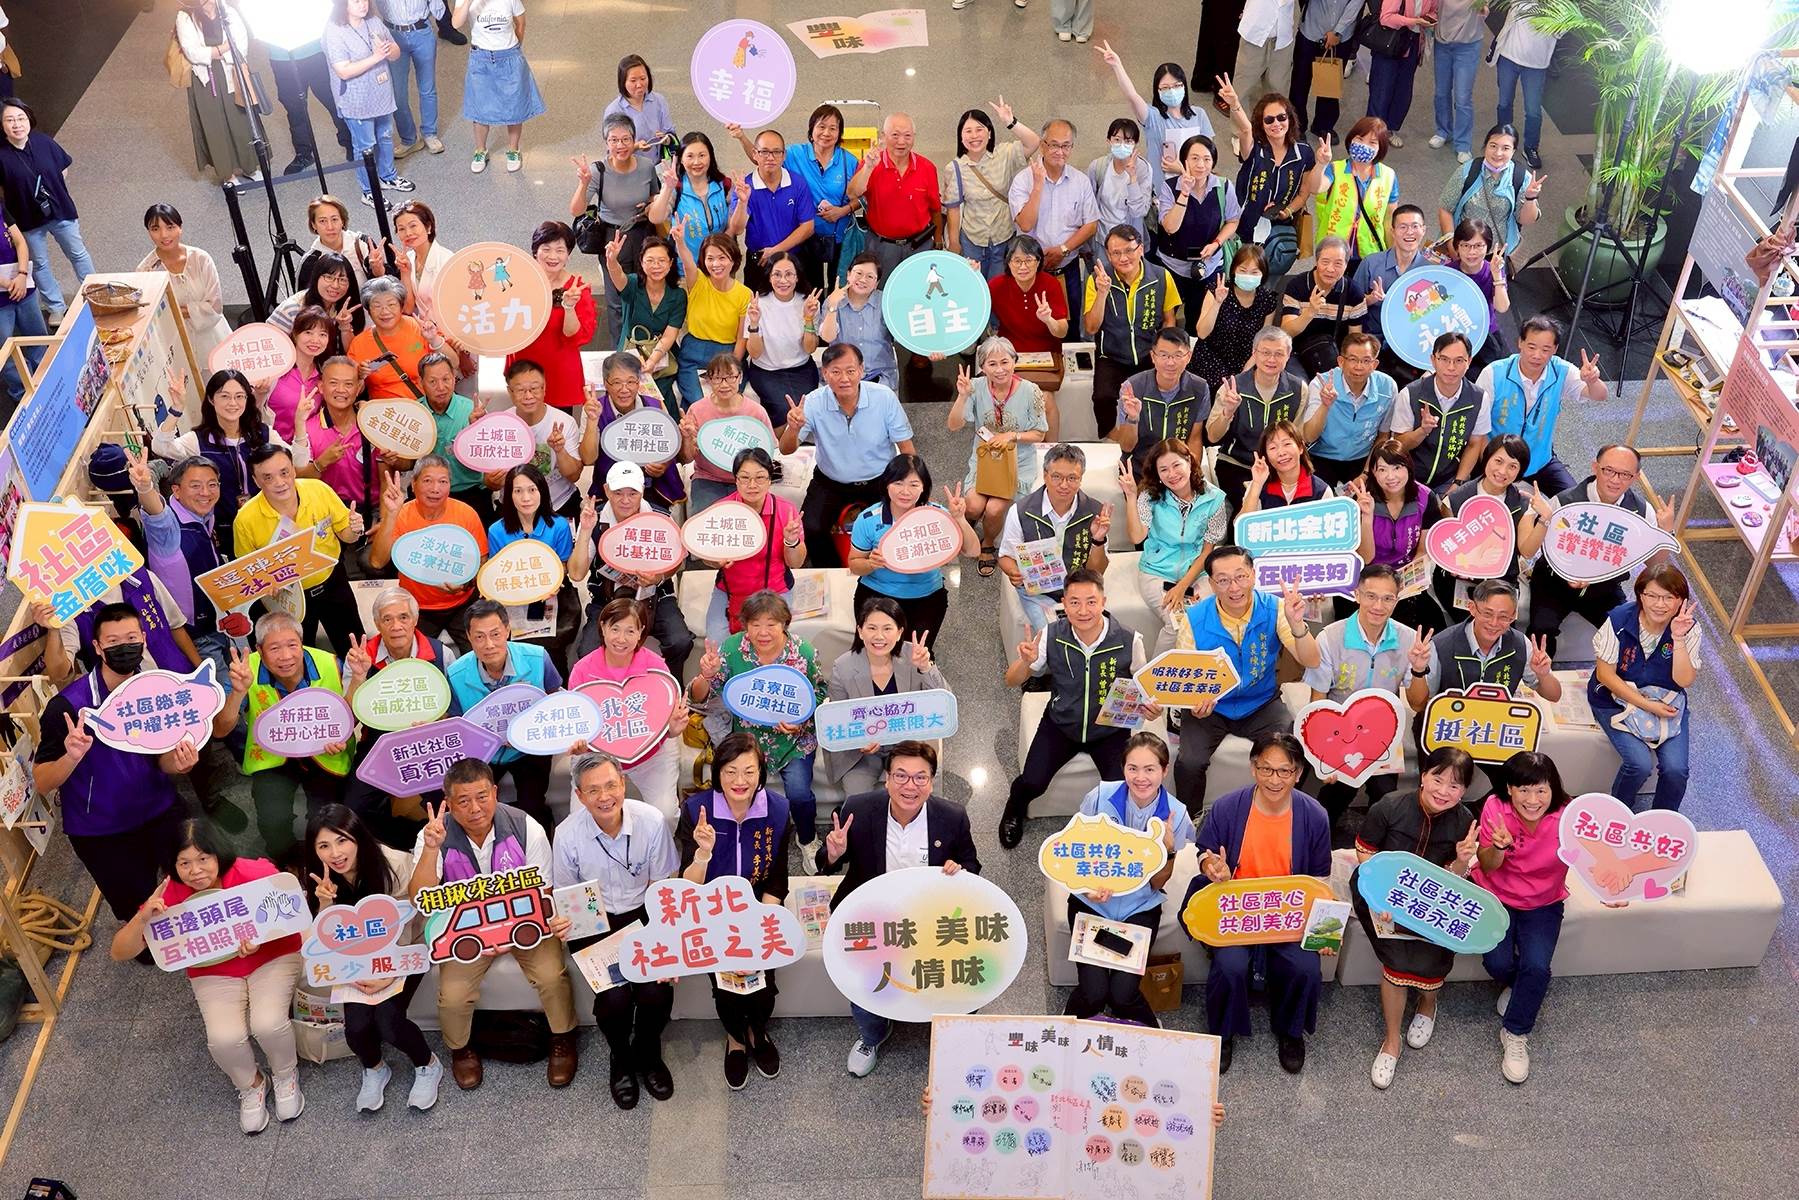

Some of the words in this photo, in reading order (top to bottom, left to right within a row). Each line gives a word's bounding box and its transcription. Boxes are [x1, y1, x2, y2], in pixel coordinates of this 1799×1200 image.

[708, 68, 776, 113] 幸福
[457, 297, 534, 336] 活力
[907, 300, 972, 337] 自主
[1418, 303, 1479, 353] 永續
[230, 337, 275, 356] 林口區
[227, 352, 285, 370] 湖南社區
[384, 406, 422, 434] 金山區
[624, 423, 664, 437] 平溪區
[368, 414, 423, 451] 金包里社區
[477, 428, 517, 443] 土城區
[722, 425, 762, 448] 新店區
[470, 444, 524, 459] 頂欣社區
[616, 438, 670, 454] 菁桐社區
[624, 527, 667, 545] 萬里區
[704, 516, 748, 532] 土城區
[898, 520, 941, 541] 中和區
[1247, 511, 1348, 542] 新北金好
[1440, 510, 1496, 555] 攜手同行
[1577, 512, 1629, 546] 社區
[421, 535, 466, 558] 淡水區
[696, 532, 755, 548] 平和社區
[895, 536, 952, 561] 碧湖社區
[18, 513, 113, 596] 社區
[409, 550, 466, 577] 忠寮社區
[615, 544, 673, 561] 北基社區
[500, 556, 543, 574] 汐止區
[1258, 560, 1348, 585] 在地共好
[51, 548, 135, 623] 金厝咪
[240, 563, 300, 597] 社區
[494, 572, 553, 593] 保長社區
[1151, 666, 1227, 679] 服務好多元、
[380, 677, 427, 693] 三芝區
[752, 678, 796, 698] 貢寮區
[1155, 681, 1222, 695] 社區金幸福
[116, 688, 194, 719] 社區織夢
[279, 706, 330, 721] 新莊區
[371, 695, 437, 715] 福成社區
[485, 699, 532, 720] 鶯歌區
[534, 706, 580, 721] 永和區
[601, 692, 648, 719] 我愛
[740, 693, 800, 717] 卯澳社區
[852, 701, 915, 720] 齊心協力
[269, 723, 342, 741] 牡丹心社區
[526, 721, 590, 741] 民權社區
[601, 718, 650, 742] 社區
[1434, 718, 1526, 748] 挺社區
[392, 733, 462, 762] 新北社區
[1573, 811, 1688, 861] 社區共好
[1053, 841, 1135, 859] 社區共好、
[1076, 859, 1144, 879] 幸福永續
[417, 866, 546, 913] 相揪來社區
[1219, 889, 1305, 911] 社區齊心
[1397, 866, 1484, 921] 社區共生
[658, 884, 749, 926] 新北
[1386, 887, 1472, 942] 幸福永續
[151, 896, 250, 942] 厝邊頭尾
[334, 919, 387, 941] 社區
[843, 918, 918, 952] 豐味
[935, 908, 1010, 946] 美味
[1219, 912, 1304, 933] 共創美好
[160, 920, 259, 966] 互相照顧
[631, 913, 795, 976] 社區之美
[313, 953, 426, 984] 兒少服務
[872, 956, 985, 994] 人情味
[1007, 1031, 1038, 1053] 豐味
[1041, 1027, 1070, 1048] 美味
[1081, 1034, 1129, 1058] 人情味
